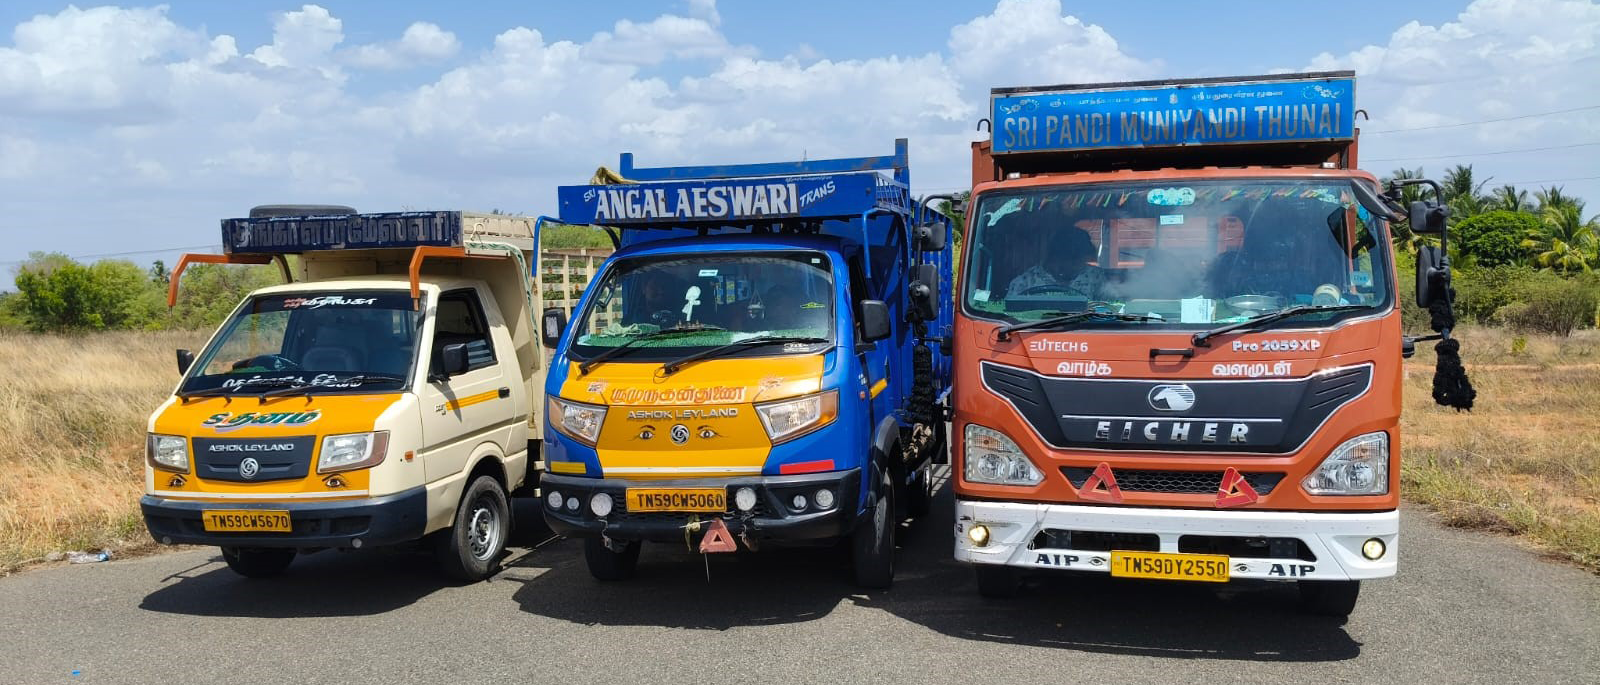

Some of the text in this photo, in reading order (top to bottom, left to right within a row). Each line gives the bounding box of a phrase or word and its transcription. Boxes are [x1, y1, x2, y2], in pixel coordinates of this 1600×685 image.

[1003, 102, 1341, 148] SRI PANDI MUNIYANDI THUNAI
[594, 183, 798, 219] ANGALAESWARI
[799, 180, 836, 208] TRANS
[1029, 338, 1089, 353] EUTECH 6
[1232, 339, 1320, 352] Pro 2059XP
[1056, 361, 1112, 376] வாழ்க
[1212, 361, 1292, 378] வளமுடன்
[627, 407, 739, 420] ASHOK LEYLAND
[1095, 421, 1250, 443] EICHER
[244, 443, 295, 451] LEYLAND
[636, 493, 724, 508] TN59CW5060
[211, 514, 289, 529] TN59CW5670
[1034, 553, 1080, 566] AIP
[1122, 556, 1227, 576] TN59DY2550
[1268, 563, 1317, 577] AIP
